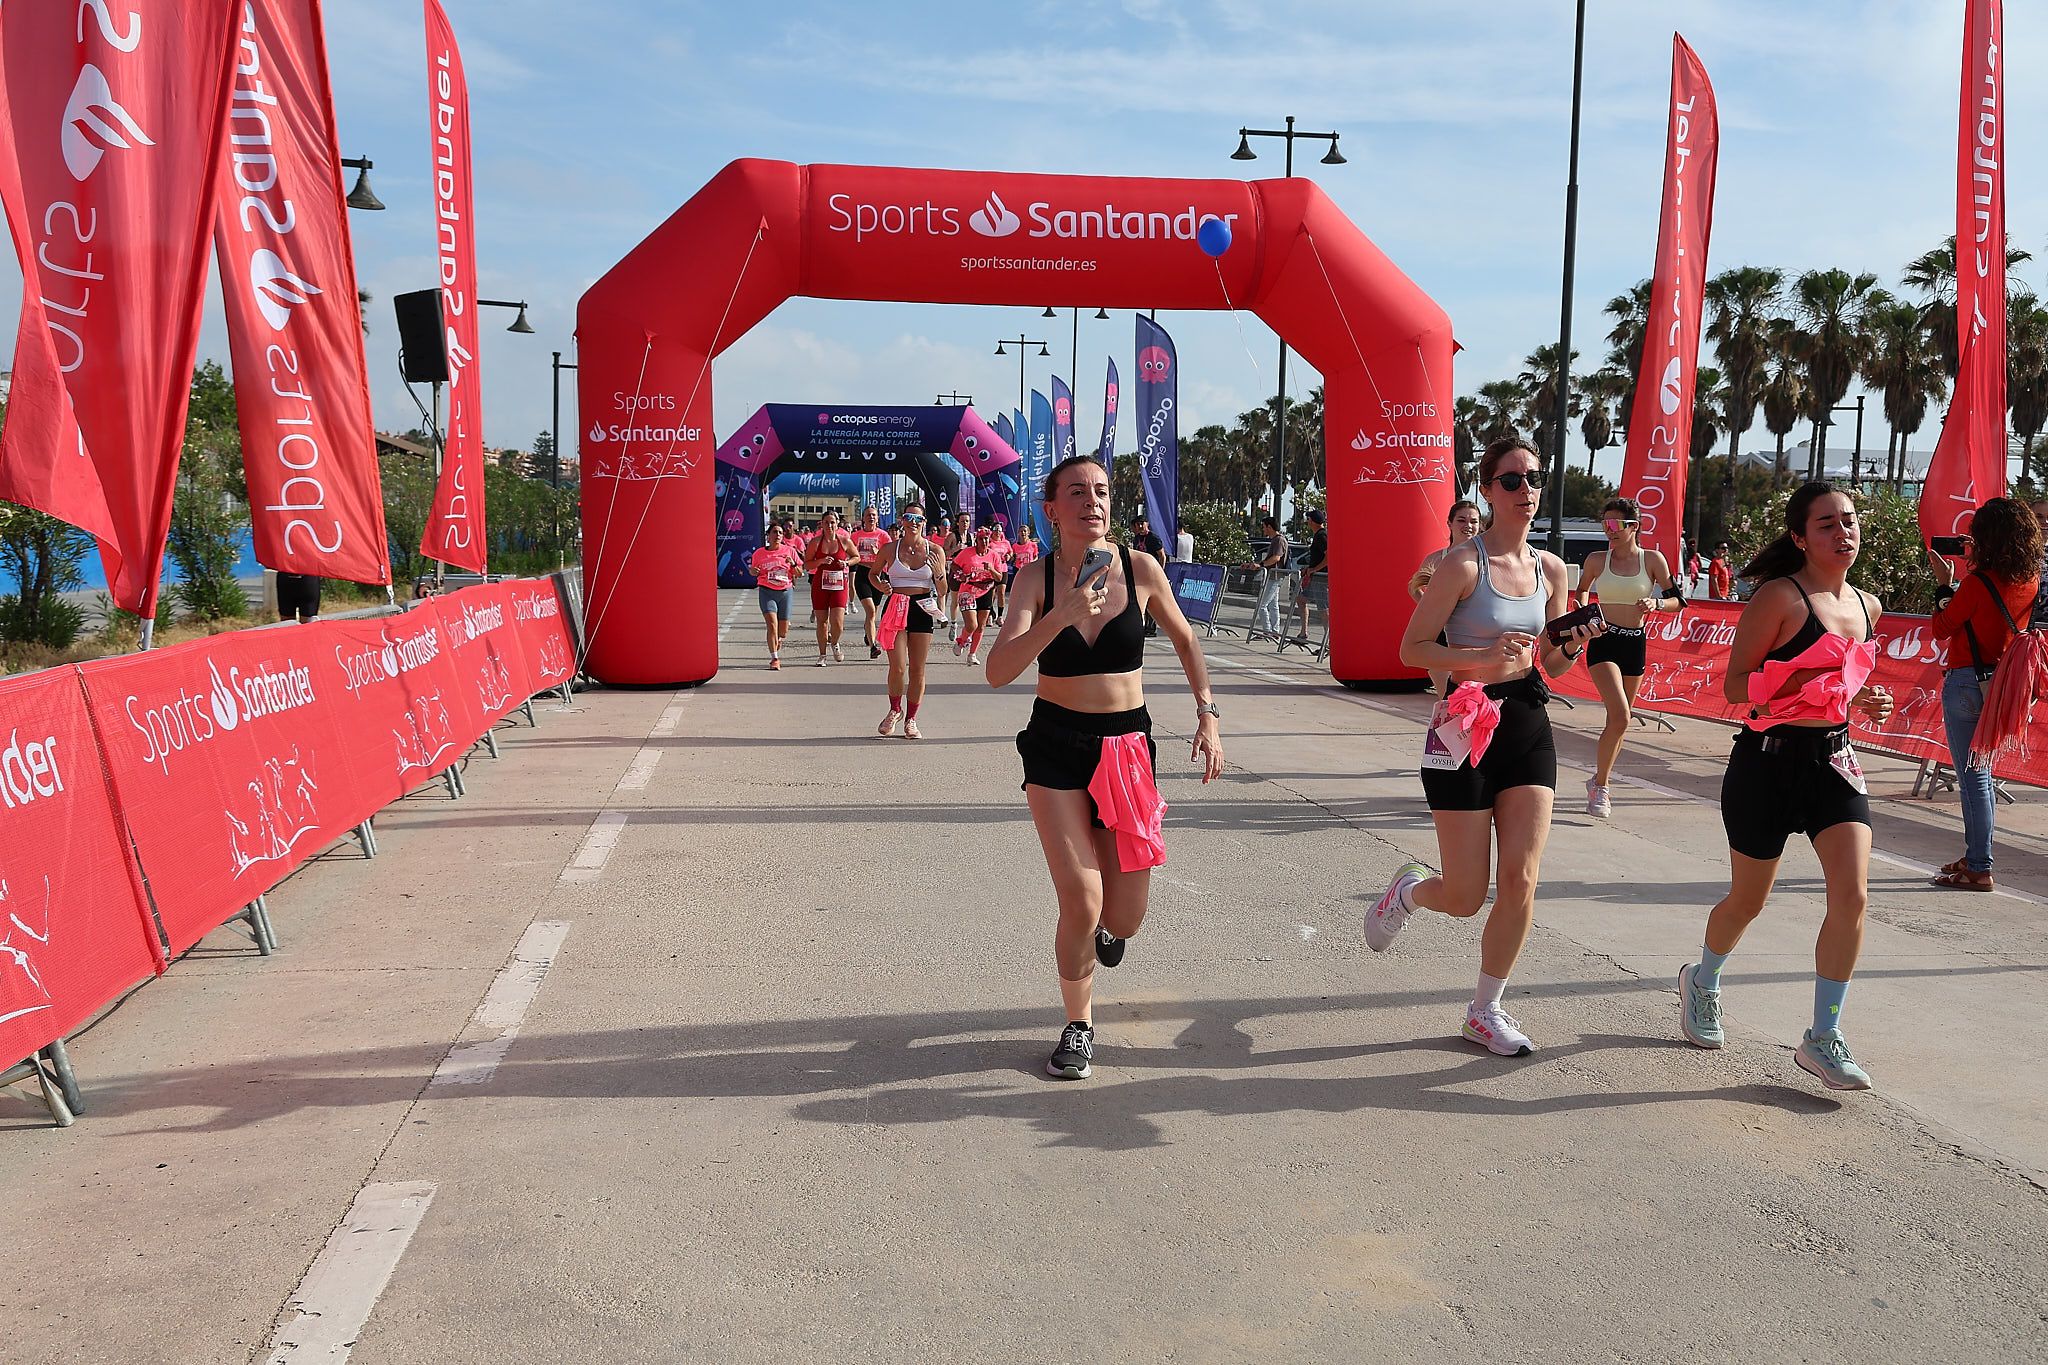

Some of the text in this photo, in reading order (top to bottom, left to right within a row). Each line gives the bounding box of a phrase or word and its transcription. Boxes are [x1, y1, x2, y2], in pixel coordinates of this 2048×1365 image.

[829, 193, 960, 242] Sports
[960, 254, 1097, 273] sportssantander.es
[613, 391, 675, 414] Sports
[1380, 400, 1436, 421] Sports
[832, 414, 916, 428] octopus energy
[609, 424, 701, 442] Santander
[811, 429, 822, 437] LA
[861, 430, 885, 438] PARA
[793, 450, 897, 460] VOLVO
[799, 473, 840, 491] Marlene
[1618, 629, 1642, 637] PRO
[125, 658, 317, 776] Sports Santander
